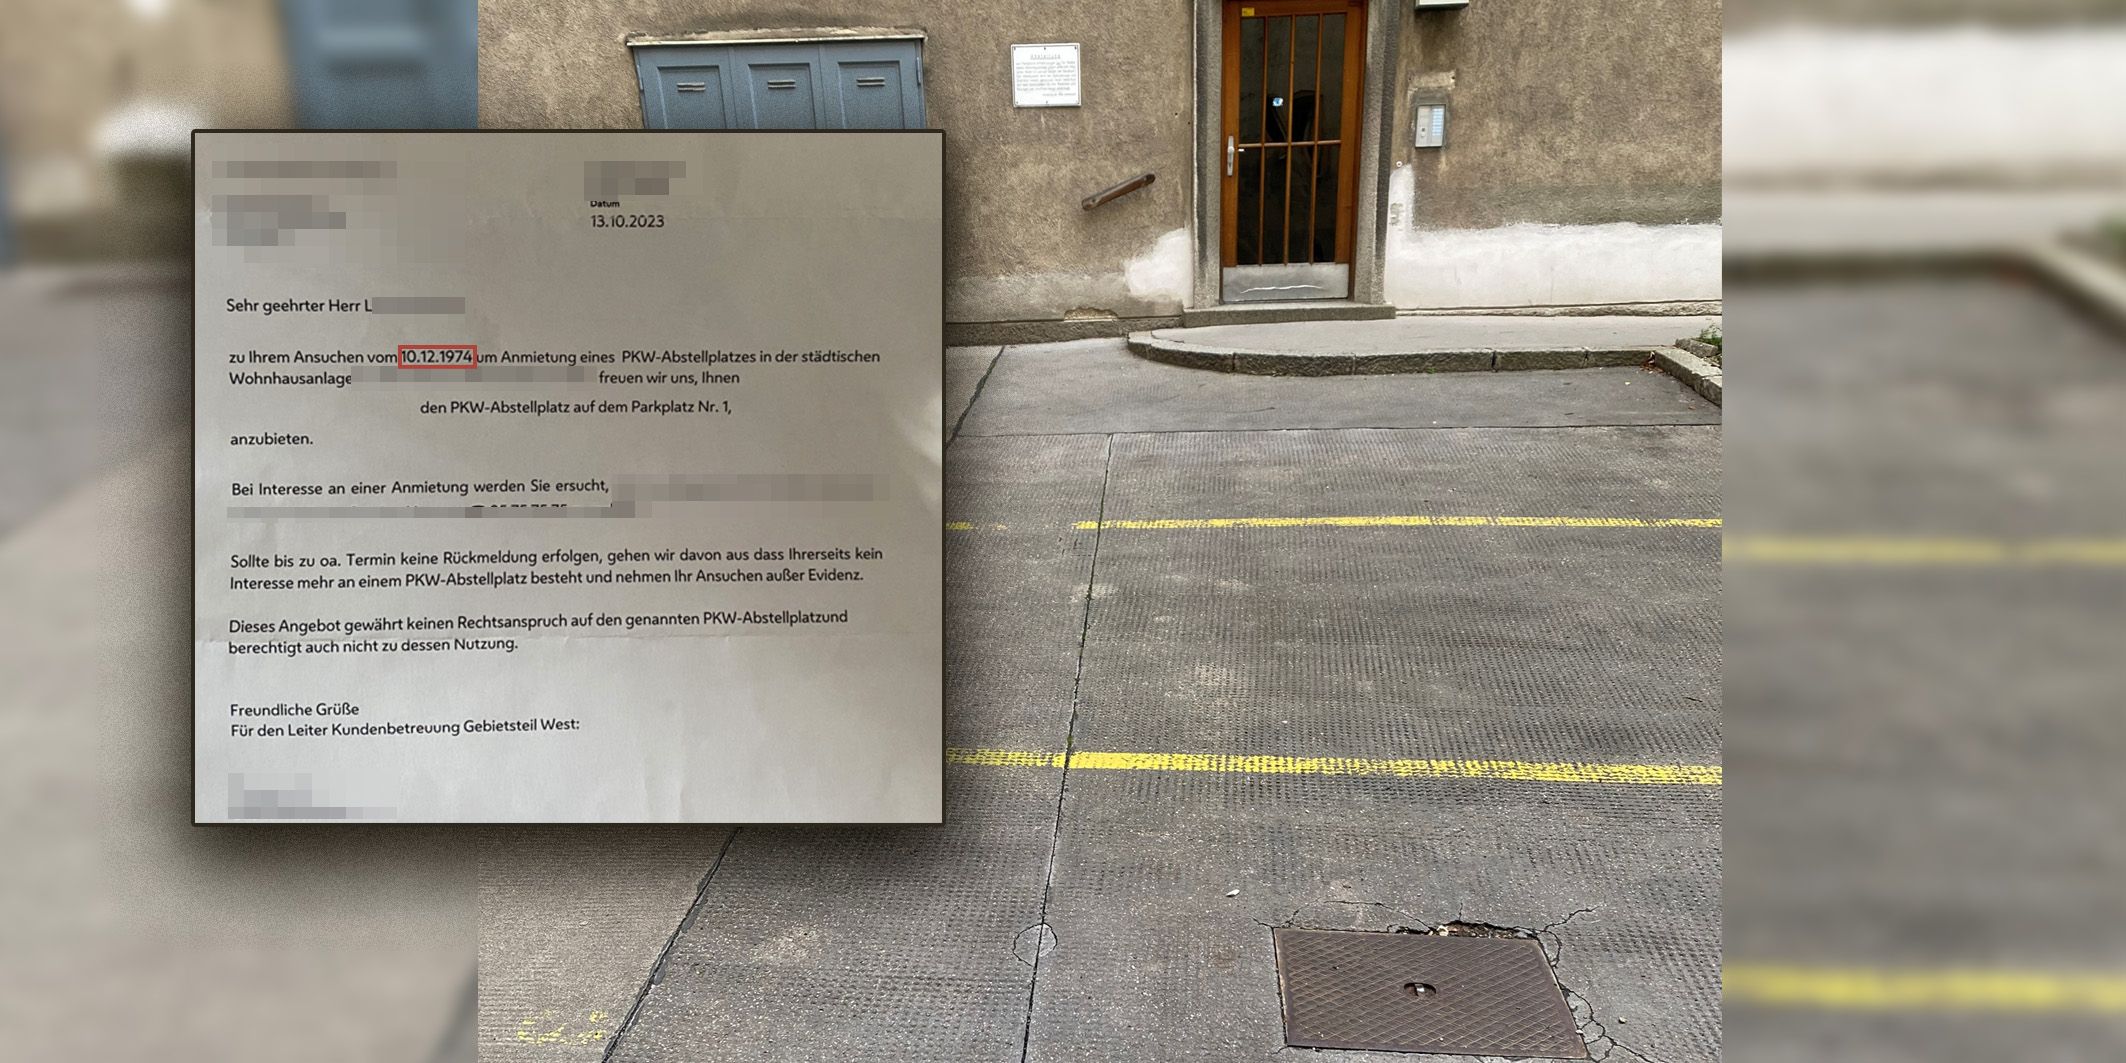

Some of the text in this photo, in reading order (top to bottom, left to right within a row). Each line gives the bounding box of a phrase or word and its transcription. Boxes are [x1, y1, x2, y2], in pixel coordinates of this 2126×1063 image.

[591, 214, 665, 228] 13.10.2023
[226, 298, 260, 313] Sehr
[262, 298, 325, 316] geehrter
[328, 298, 361, 313] Herr
[229, 349, 881, 367] zu Ihrem Ansuchen vom 10.12.1974 um Anmietung eines PKW-Abstellplatzes in der städtischen
[228, 371, 352, 389] Wohnhausanlage
[598, 370, 644, 384] freuen
[646, 371, 668, 384] wir
[670, 374, 698, 386] uns,
[701, 370, 740, 384] Ihnen
[420, 399, 732, 417] den PKW-Abstellplatz auf dem Parkplatz Nr. 1,
[230, 431, 314, 446] anzubieten.
[231, 482, 254, 496] Bei
[259, 482, 323, 496] Interesse
[327, 485, 346, 495] an
[350, 481, 387, 495] einer
[391, 480, 469, 497] Anmietung
[473, 479, 526, 493] werden
[530, 478, 551, 493] Sie
[555, 478, 609, 494] ersucht,
[230, 546, 883, 569] Sollte bis zu oa. Termin keine Rückmeldung erfolgen, gehen wir davon aus dass Ihrerseits kein
[230, 567, 864, 590] Interesse mehr an einem PKW-Abstellplatz besteht und nehmen Ihr Ansuchen außer Evidenz.
[229, 609, 848, 637] Dieses Angebot gewährt keinen Rechtsanspruch auf den genannten PKW-Abstellplatzund
[228, 638, 519, 658] berechtigt auch nicht zu dessen Nutzung.
[230, 701, 360, 717] Freundliche Grüße
[231, 718, 580, 737] Für den Leiter Kundenbetreuung Gebietsteil West:
